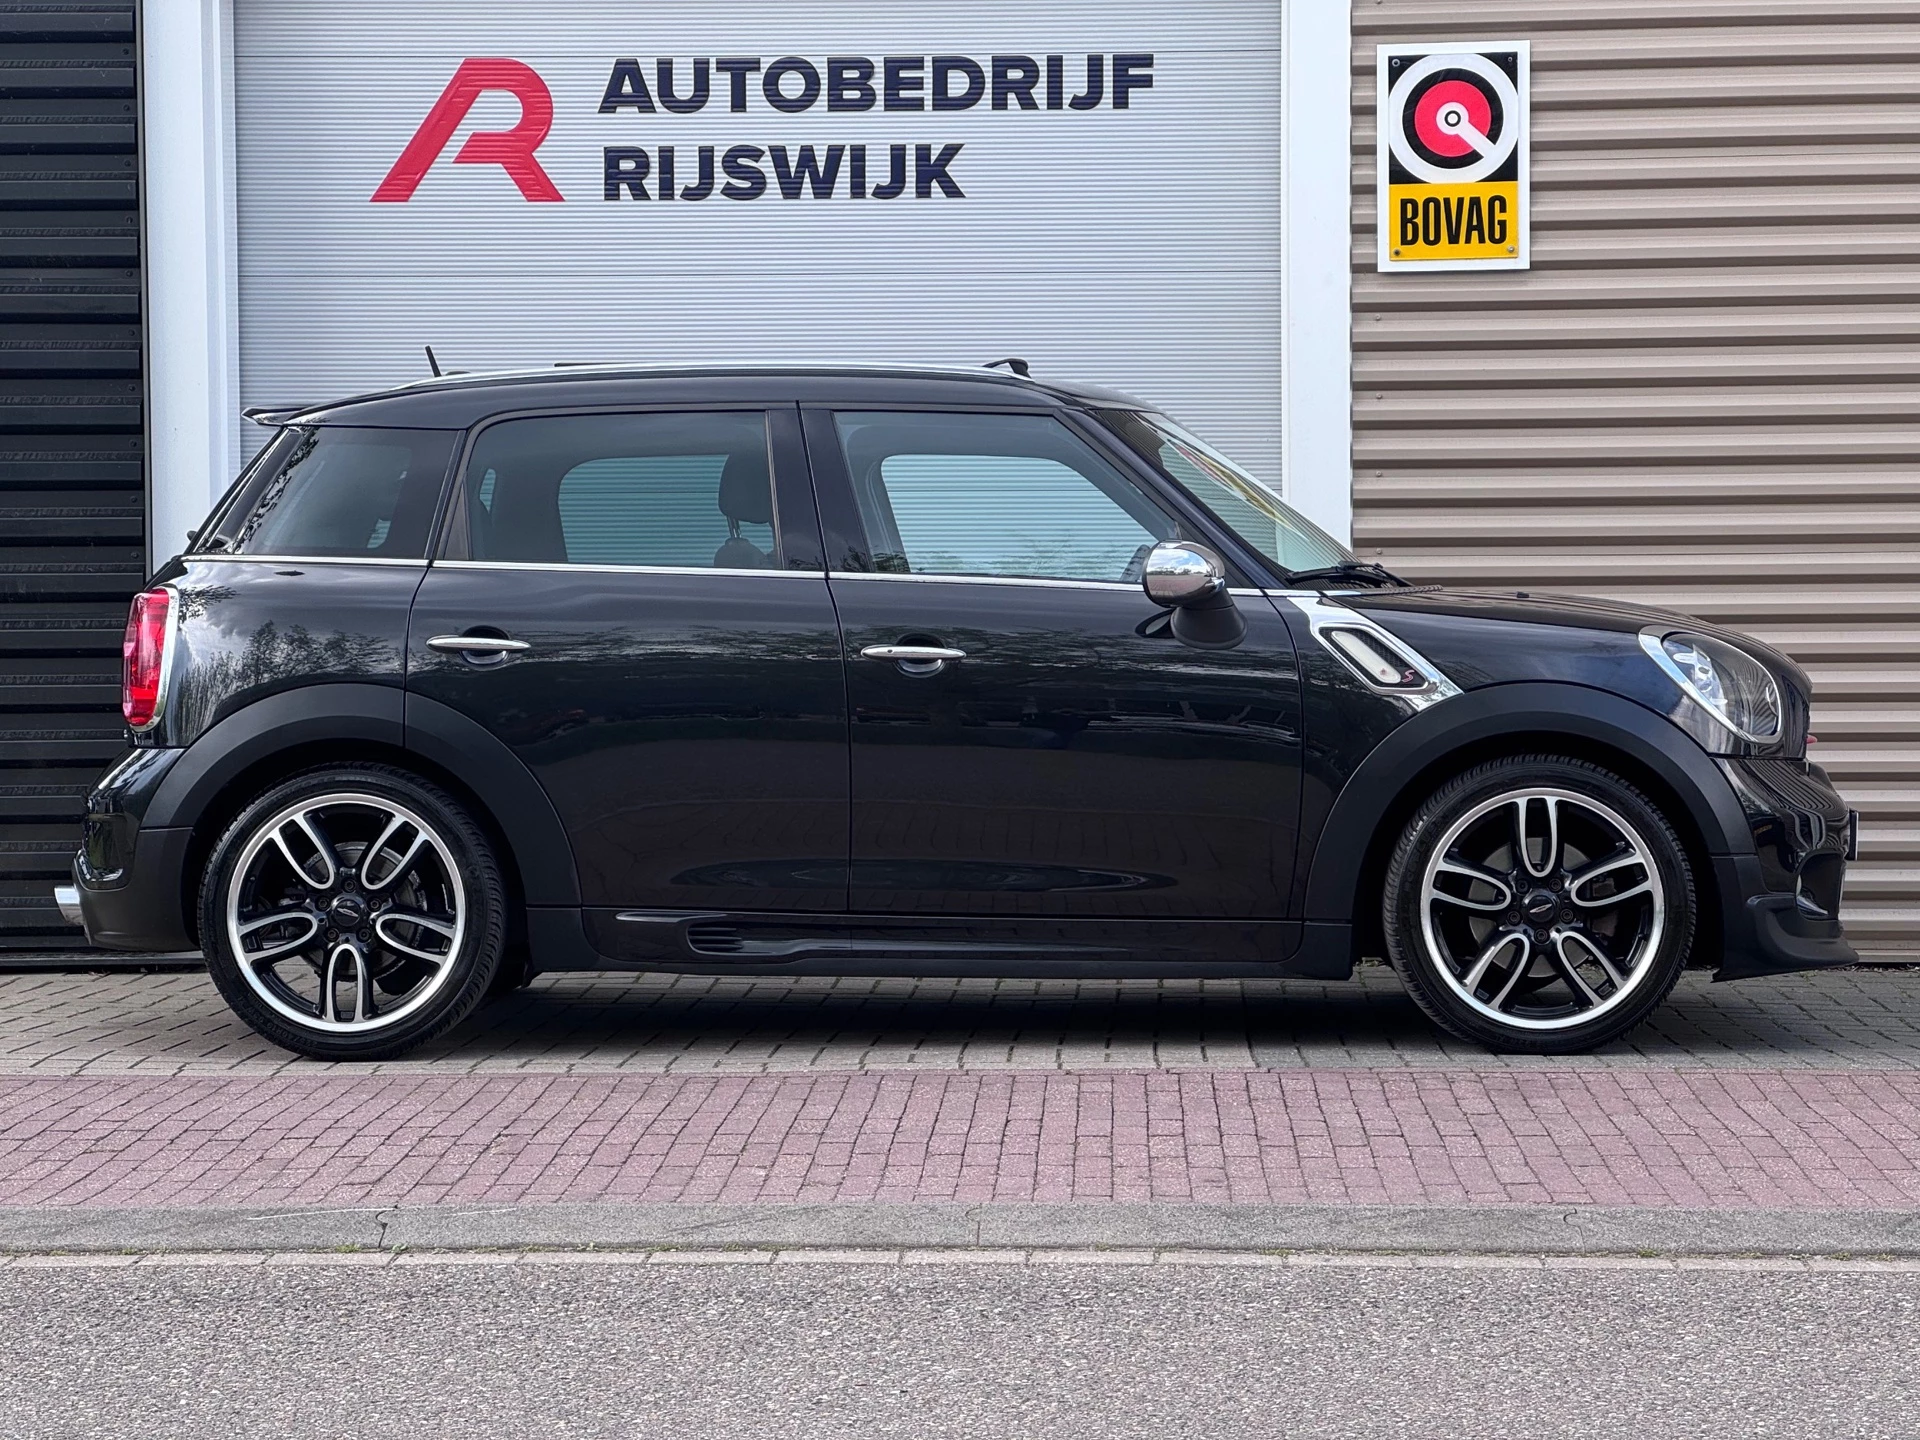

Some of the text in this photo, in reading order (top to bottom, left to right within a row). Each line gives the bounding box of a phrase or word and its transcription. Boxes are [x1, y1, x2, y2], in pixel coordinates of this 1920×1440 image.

[598, 52, 1155, 114] AUTOBEDRIJF
[603, 143, 966, 202] RIJSWIJK
[1400, 194, 1508, 246] BOVAG
